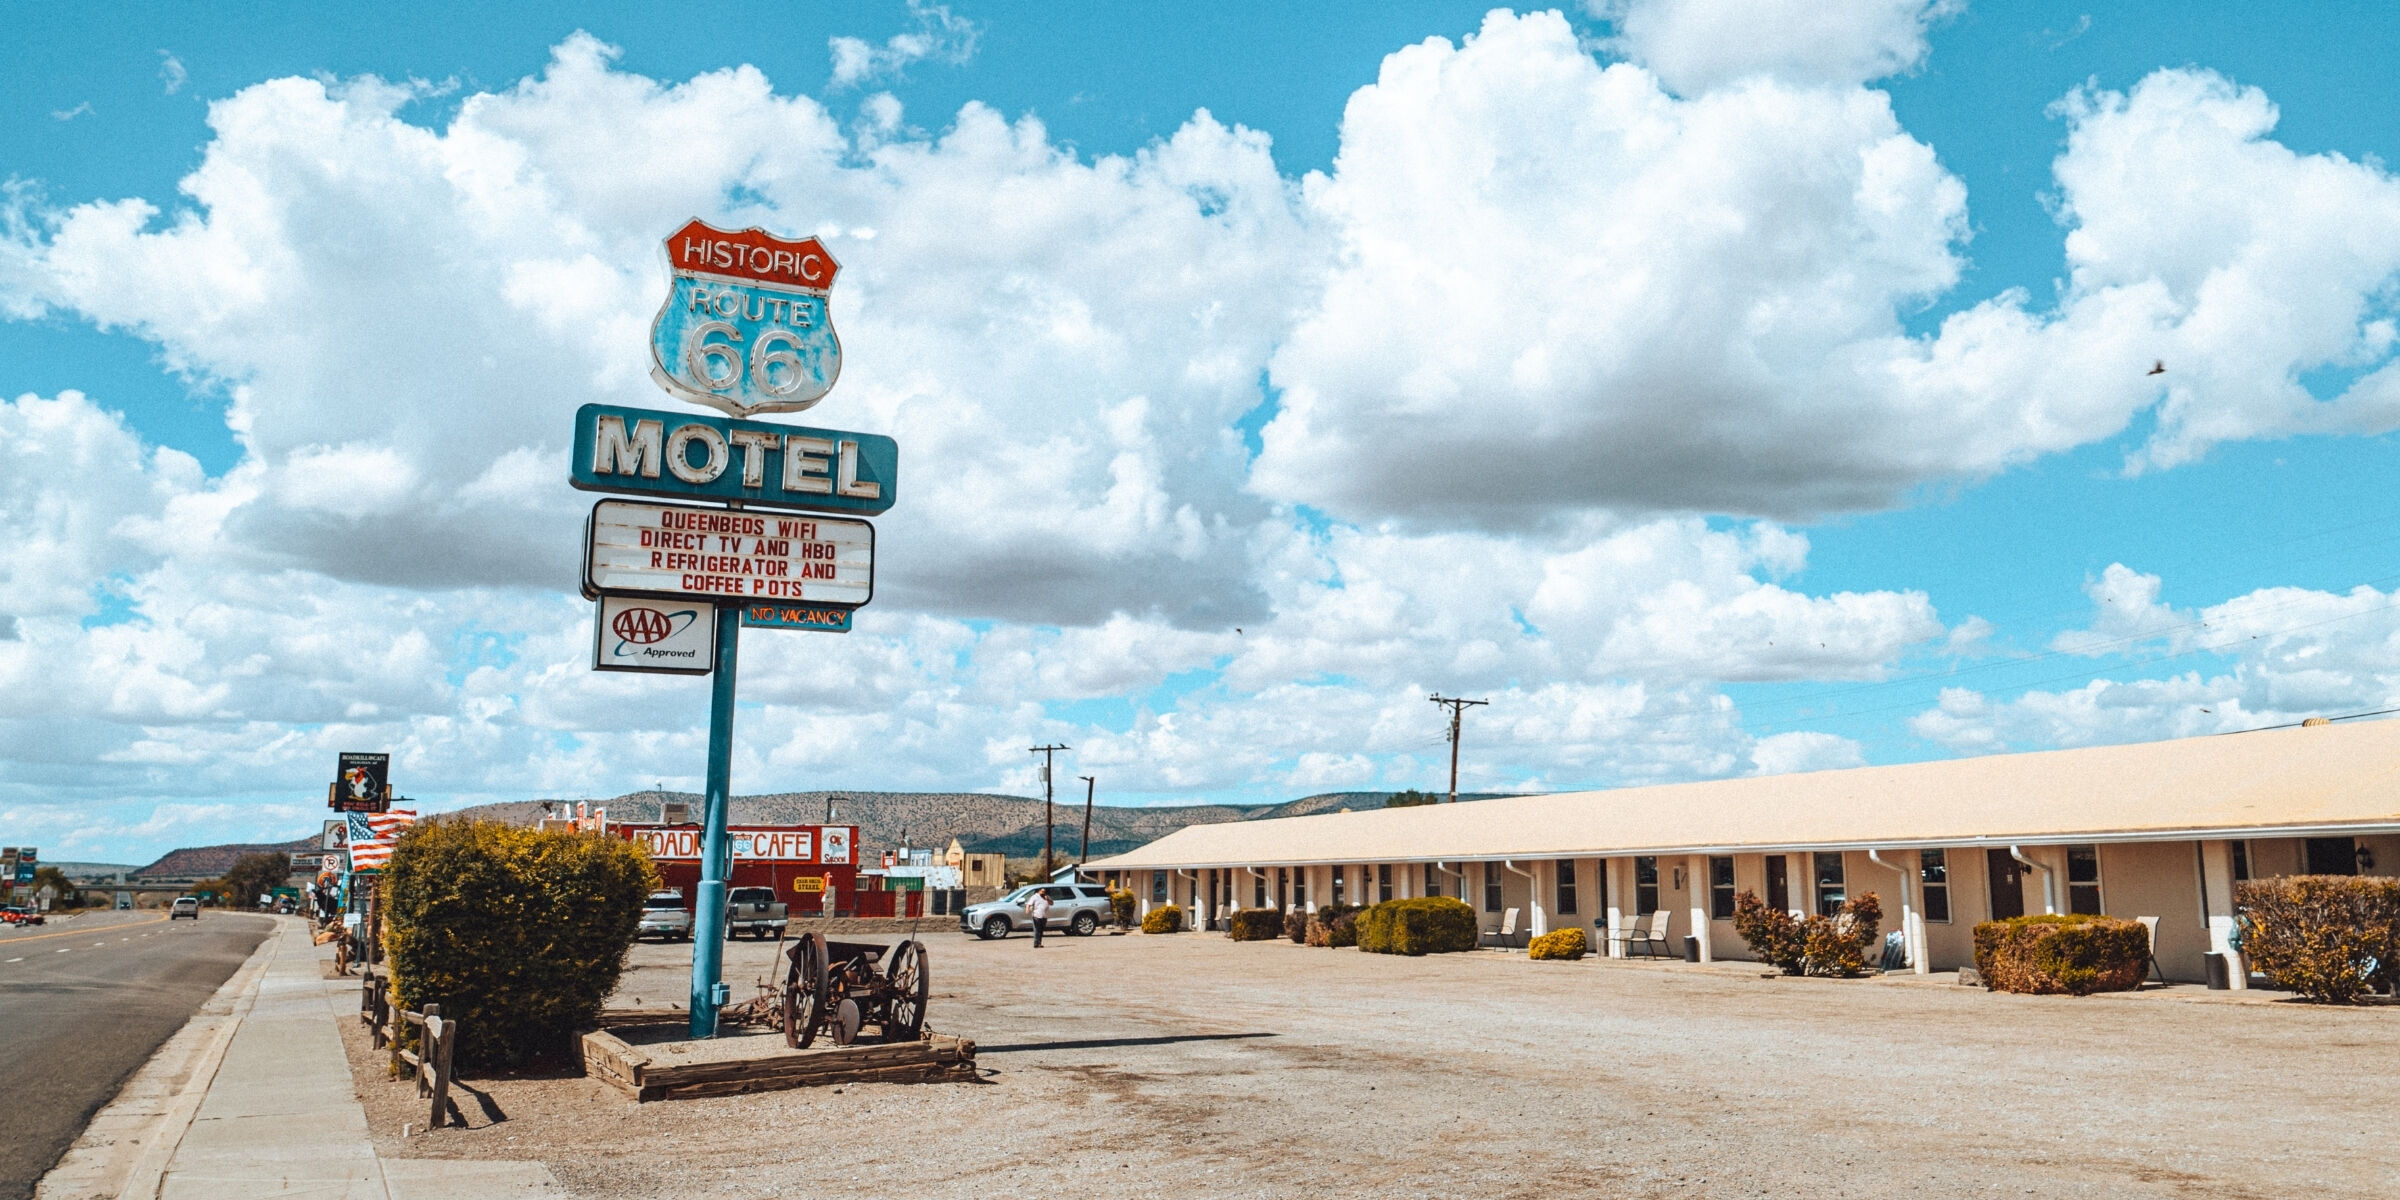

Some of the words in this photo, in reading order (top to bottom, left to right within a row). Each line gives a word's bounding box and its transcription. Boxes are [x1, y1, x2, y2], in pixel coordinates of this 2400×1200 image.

[683, 237, 822, 281] HISTORIC
[689, 287, 812, 328] ROUTE
[687, 321, 804, 396] 66
[592, 415, 881, 499] MOTEL
[661, 511, 765, 536] QUEENBEDS
[778, 520, 817, 539] WIFI
[640, 530, 707, 551] DIRECT
[719, 536, 742, 553] TV
[754, 539, 789, 557] AND
[802, 542, 836, 560] HBO
[651, 551, 788, 576] REFRIGERATOR
[801, 562, 836, 579] AND
[682, 574, 744, 594] COFFEE
[753, 579, 802, 597] POTS
[617, 608, 668, 644] AAA
[752, 607, 775, 622] NO
[780, 608, 847, 626] VACANCY
[643, 647, 695, 659] Approved
[753, 833, 810, 857] CAFE
